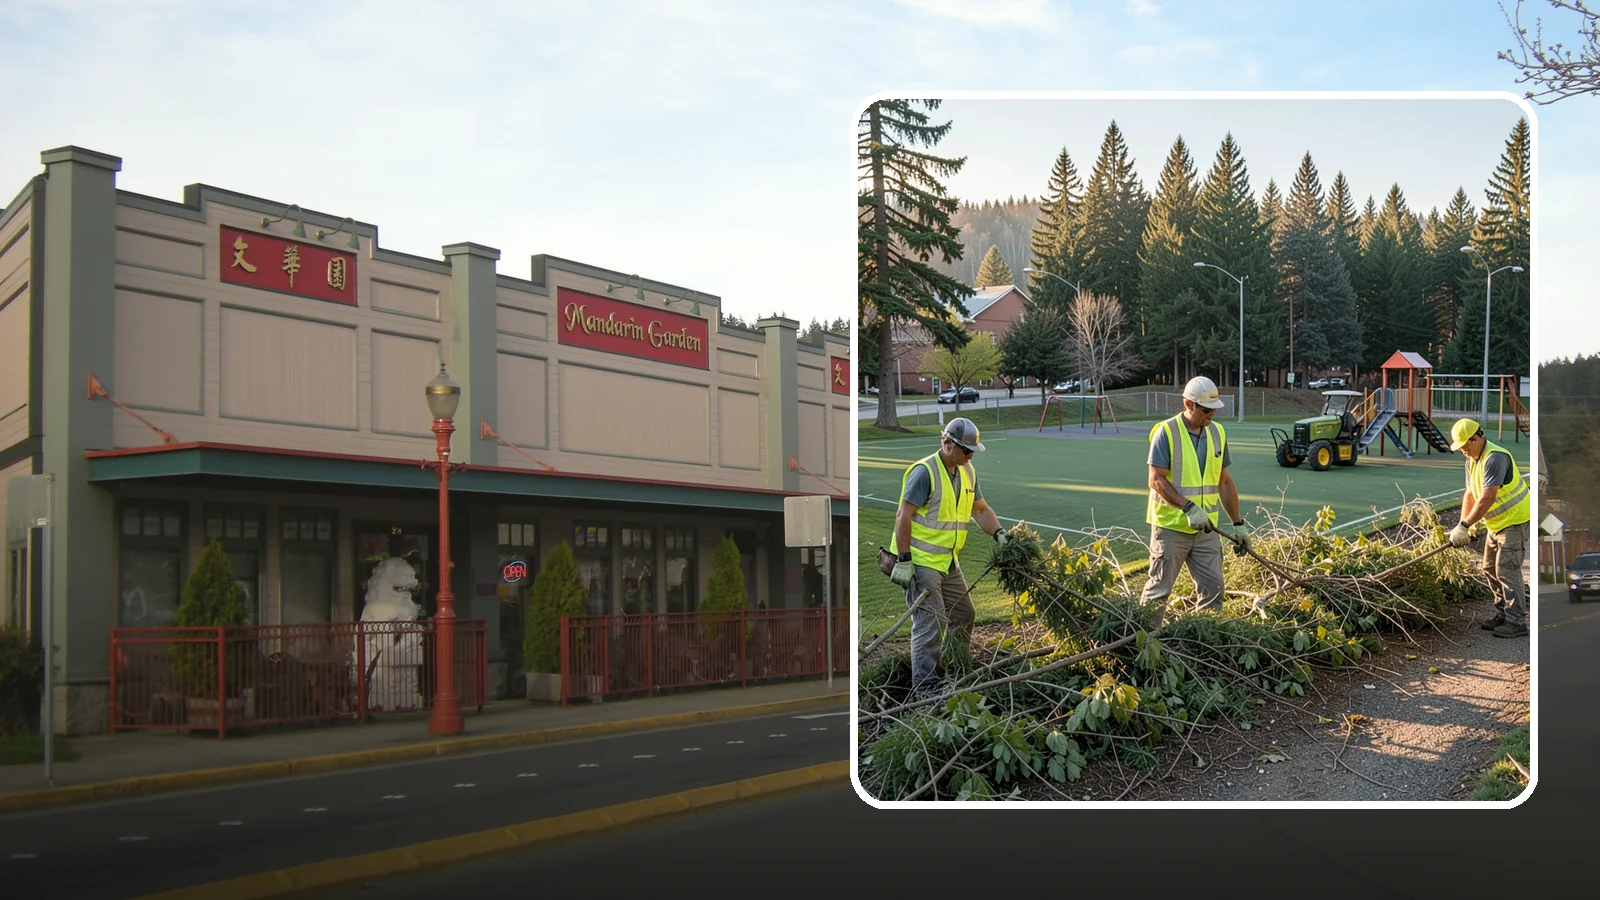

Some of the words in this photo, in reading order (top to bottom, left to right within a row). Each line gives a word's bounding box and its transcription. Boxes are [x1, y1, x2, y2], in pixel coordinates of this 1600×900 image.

[230, 235, 346, 291] 文華園
[564, 302, 644, 341] Mandarin
[648, 320, 701, 352] Garden
[503, 565, 527, 578] OPEN
